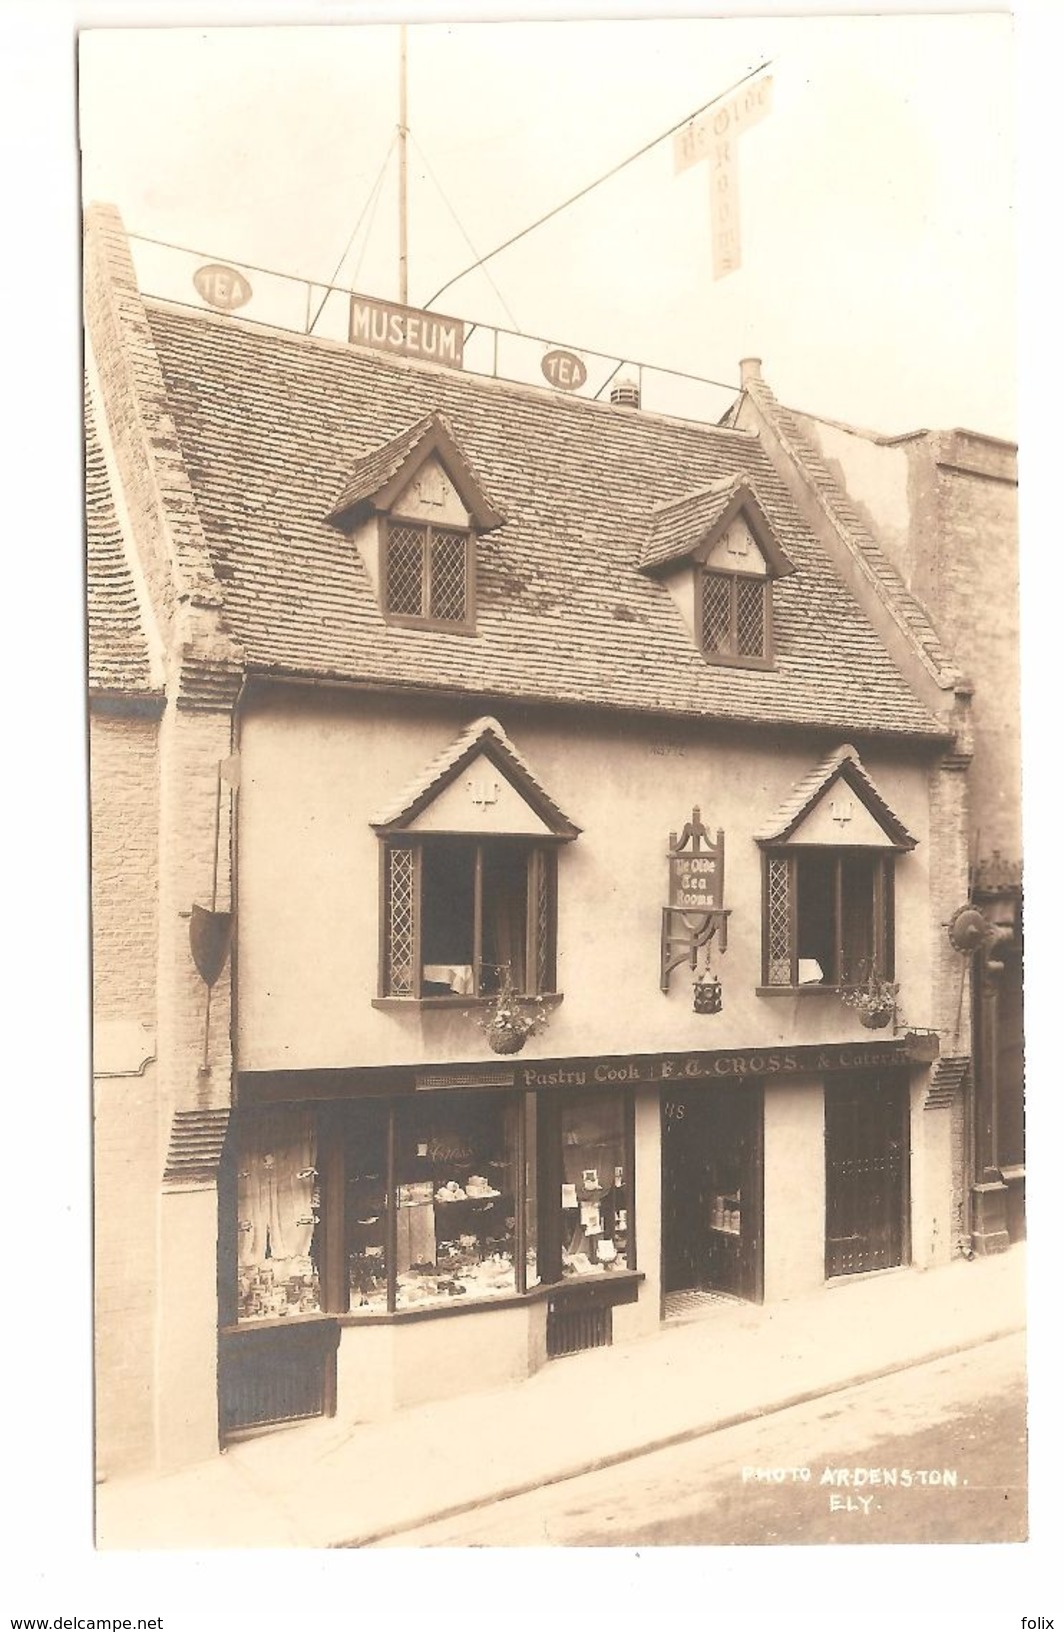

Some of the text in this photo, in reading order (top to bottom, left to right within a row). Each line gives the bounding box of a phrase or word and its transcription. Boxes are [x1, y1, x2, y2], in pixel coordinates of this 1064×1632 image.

[202, 275, 244, 303] TEA
[353, 303, 462, 362] MUSEUM.
[547, 357, 582, 384] TEA
[522, 1069, 586, 1086] Pastry
[594, 1063, 641, 1082] Cook
